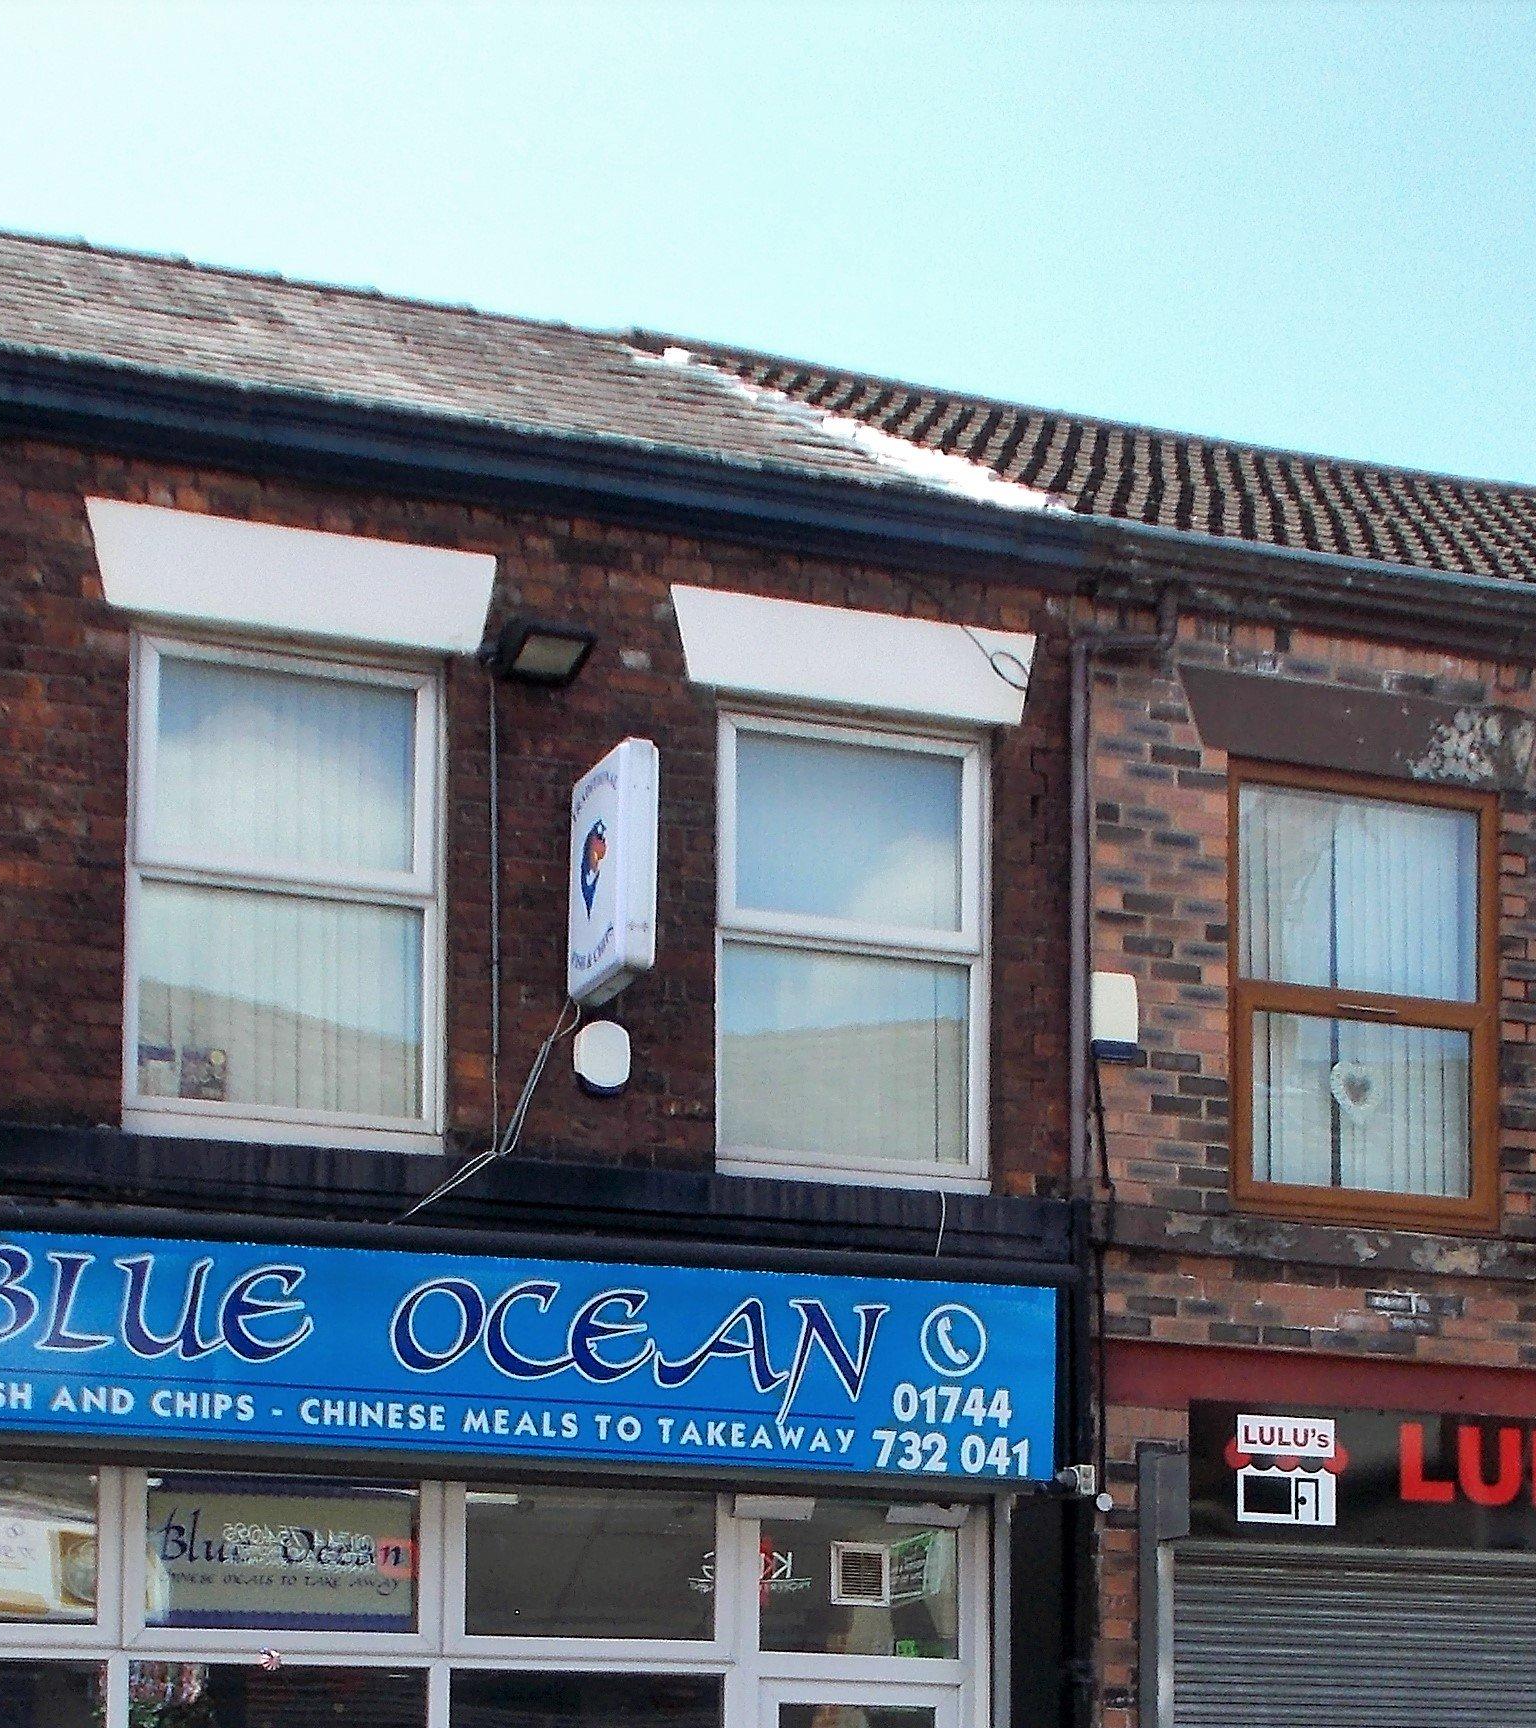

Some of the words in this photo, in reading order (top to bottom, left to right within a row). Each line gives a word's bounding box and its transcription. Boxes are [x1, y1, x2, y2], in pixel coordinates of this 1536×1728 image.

[390, 1277, 889, 1424] OCEAN
[50, 1386, 136, 1416] AND
[151, 1391, 256, 1421] CHIPS
[300, 1399, 447, 1431] CHINESE
[463, 1408, 570, 1438] MEALS
[594, 1415, 643, 1442] TO
[658, 1418, 855, 1453] TAKEAWAY
[892, 1382, 1012, 1428] 01744
[871, 1430, 948, 1472] 732
[960, 1434, 1029, 1477] 041
[1244, 1424, 1330, 1448] LULU's
